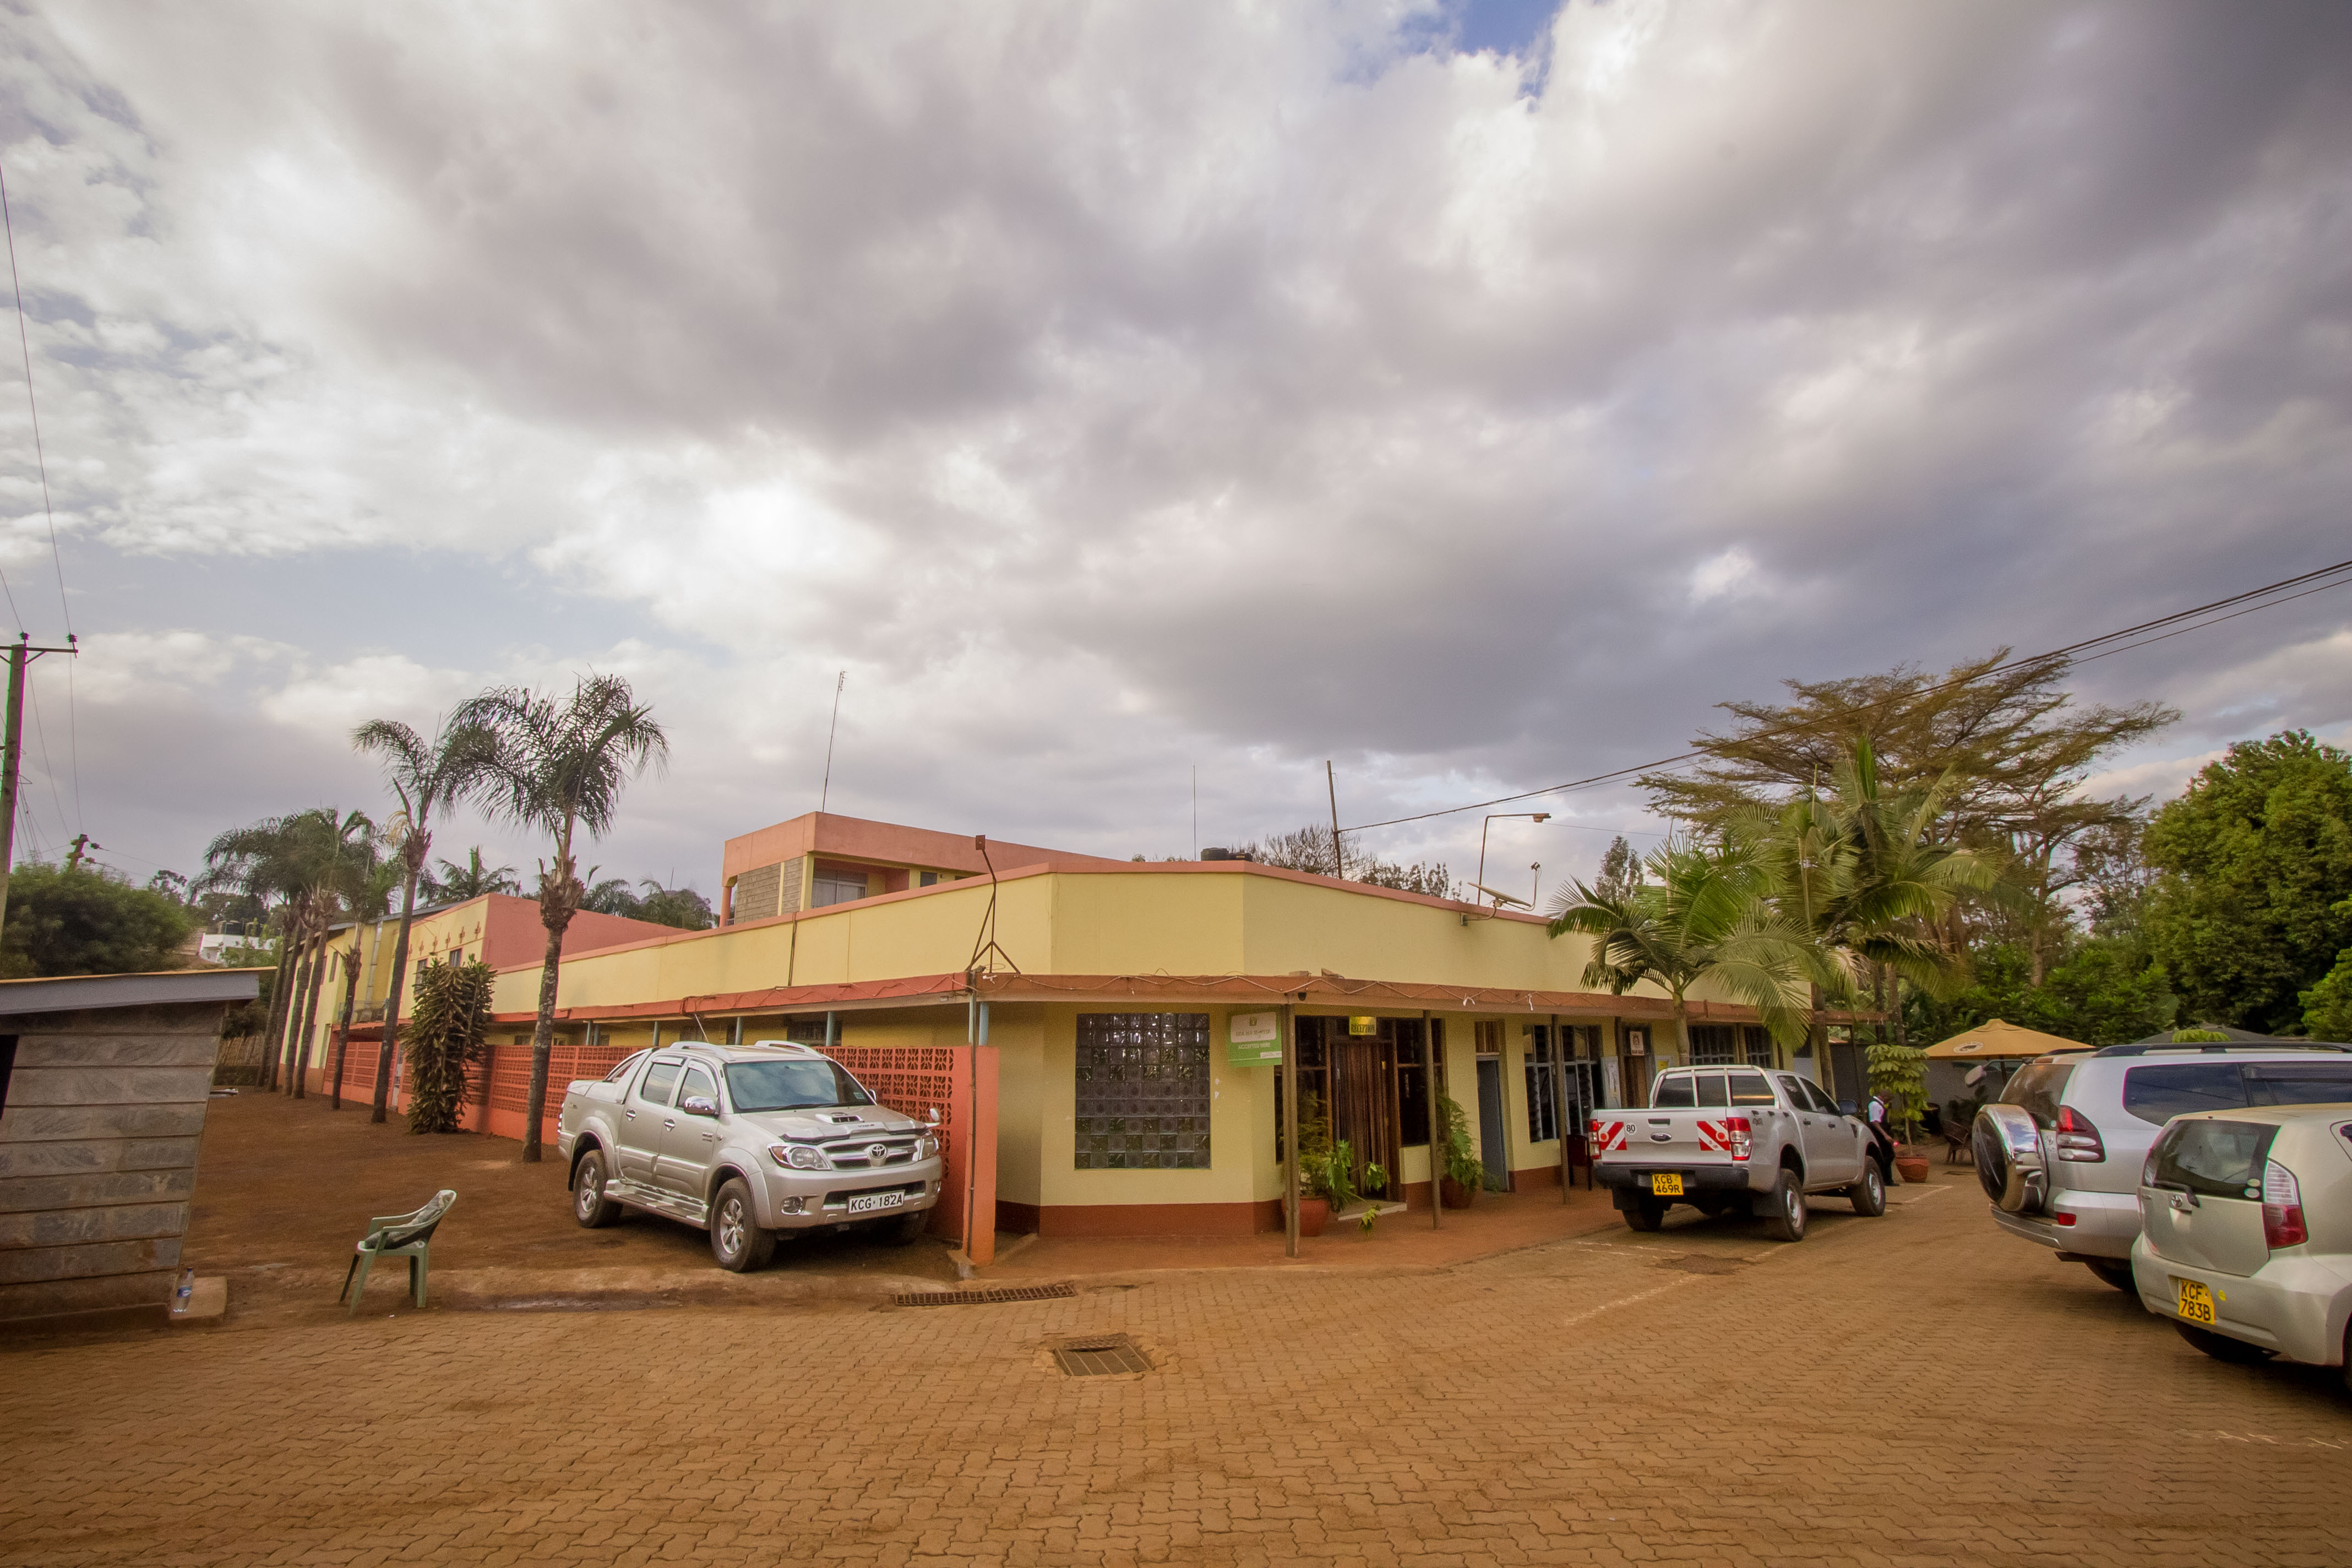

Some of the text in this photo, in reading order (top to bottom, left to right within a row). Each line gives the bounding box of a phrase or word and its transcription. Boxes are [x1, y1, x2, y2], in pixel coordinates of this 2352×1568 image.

[1351, 1025, 1375, 1033] RECEPTION
[1654, 1174, 1673, 1184] KCB
[1656, 1184, 1680, 1194] 469R
[851, 1194, 902, 1211] KCG 182A
[2181, 1281, 2203, 1301] KCF
[2180, 1298, 2211, 1321] 783B
